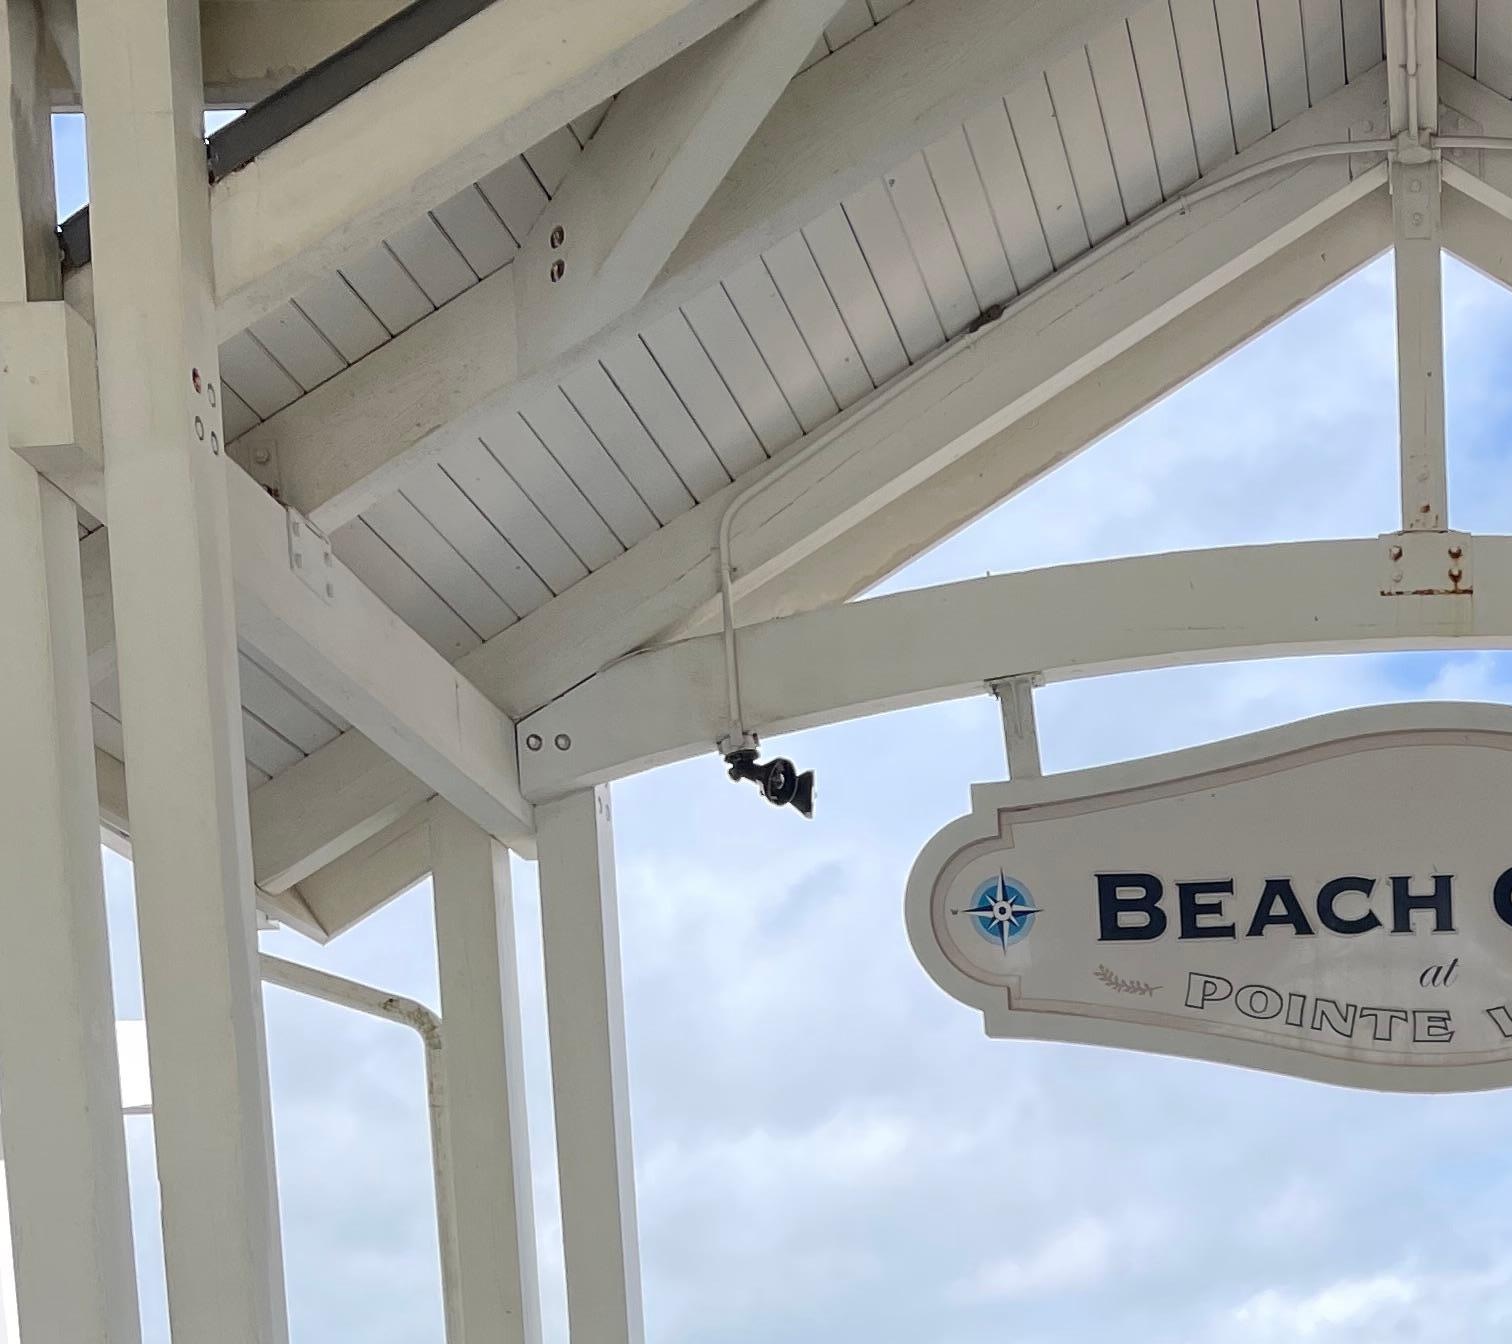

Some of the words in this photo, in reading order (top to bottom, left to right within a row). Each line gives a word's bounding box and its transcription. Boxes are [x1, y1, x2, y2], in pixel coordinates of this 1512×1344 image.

[1094, 872, 1456, 941] BEACH
[1184, 971, 1456, 1043] POINTE
[1419, 957, 1460, 988] at
